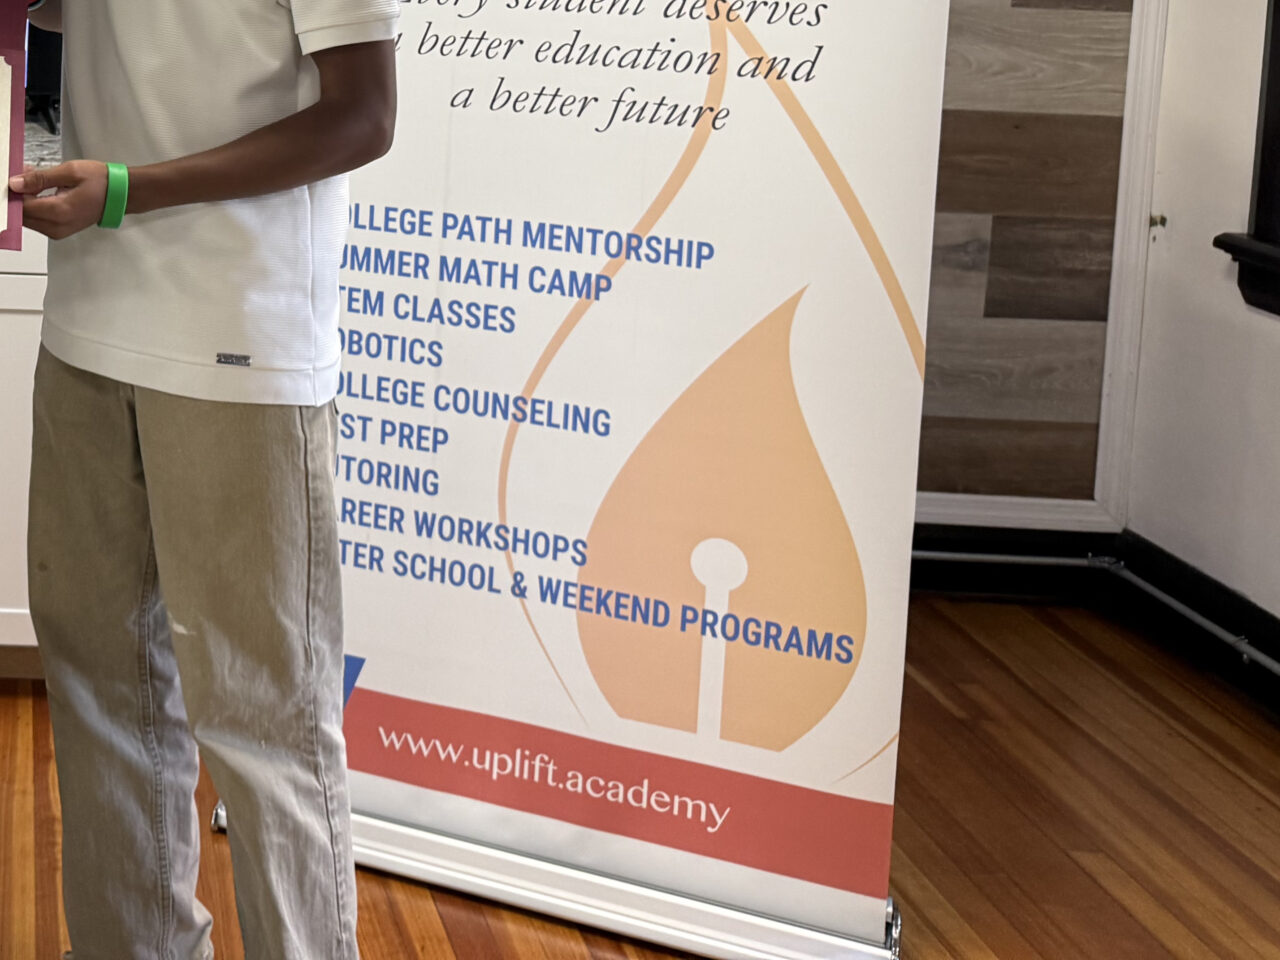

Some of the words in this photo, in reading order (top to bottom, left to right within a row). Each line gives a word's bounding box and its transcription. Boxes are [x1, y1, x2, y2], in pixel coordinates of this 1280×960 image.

[417, 21, 524, 60] better
[534, 30, 722, 76] education
[736, 45, 824, 84] and
[449, 85, 473, 109] a
[489, 77, 598, 119] better
[594, 88, 731, 133] future
[349, 202, 433, 238] LLEGE
[441, 211, 513, 247] PATH
[521, 221, 715, 270] MENTORSHIP
[339, 243, 430, 280] MMER
[438, 255, 520, 291] MATH
[527, 265, 613, 302] CAMP
[338, 285, 385, 318] EM
[393, 293, 517, 334] CLASSES
[338, 327, 443, 368] BOTICS
[337, 370, 426, 408] LLEGE
[433, 384, 612, 438] COUNSELING
[340, 412, 373, 442] ST
[380, 419, 449, 454] PREP
[336, 453, 440, 497] TORING
[340, 497, 406, 534] REER
[413, 509, 588, 567] WORKSHOPS
[339, 538, 385, 573] TER
[392, 550, 502, 595] SCHOOL
[510, 570, 529, 599] &
[537, 575, 671, 629] WEEKEND
[679, 604, 856, 665] PROGRAMS
[378, 726, 731, 833] www.uplift.academy
